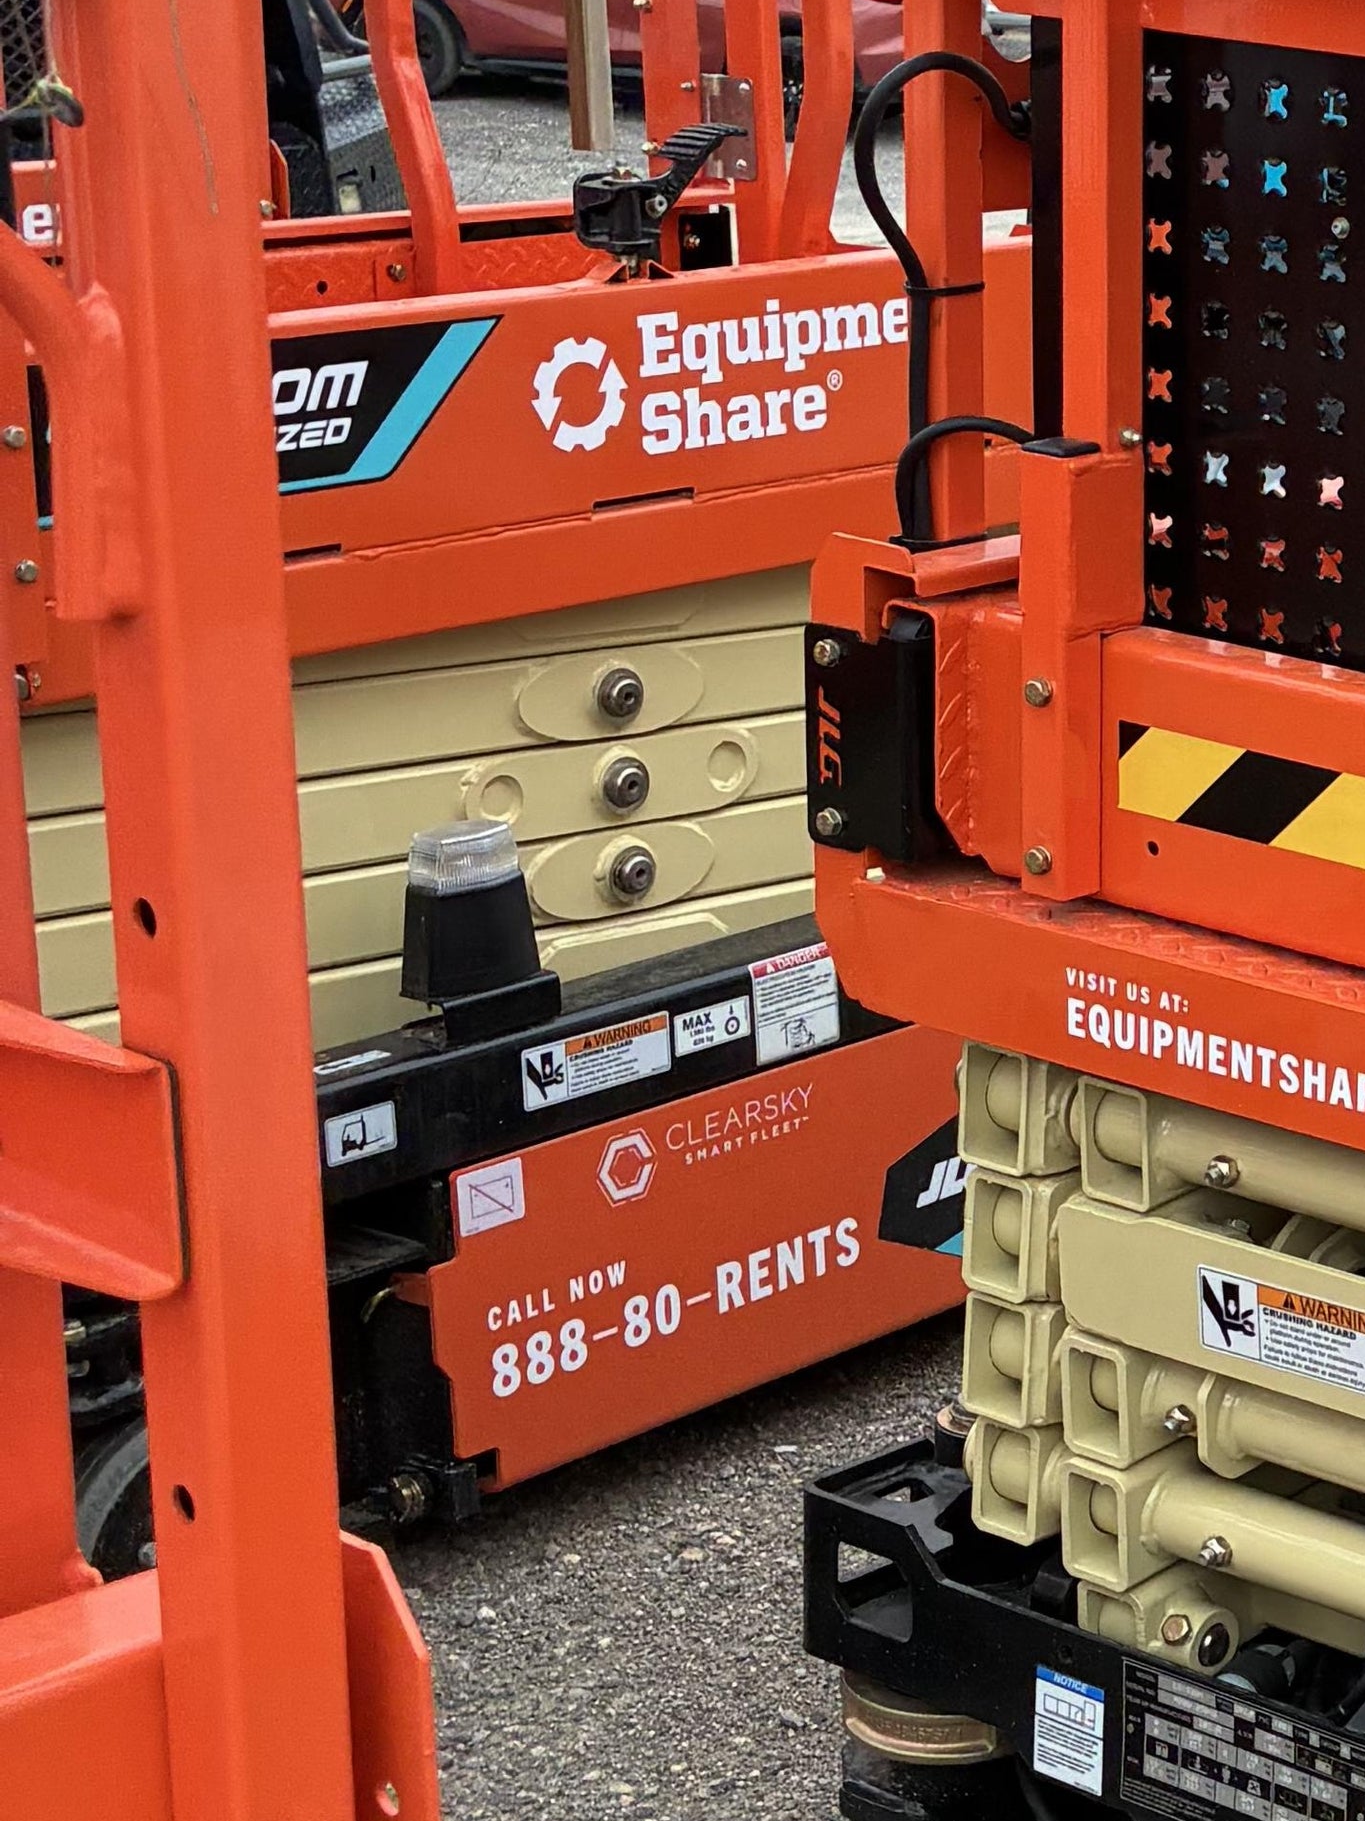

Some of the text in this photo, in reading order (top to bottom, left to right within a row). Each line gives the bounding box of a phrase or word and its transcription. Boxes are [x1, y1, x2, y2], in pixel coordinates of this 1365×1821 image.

[636, 298, 908, 385] Equipme
[819, 685, 842, 787] JLG
[1065, 967, 1190, 1013] VISIT US AT:
[594, 1020, 651, 1046] WARNING
[682, 1012, 712, 1031] MAX
[665, 1083, 813, 1151] CLEARSKY
[685, 1137, 743, 1165] SMART
[487, 1260, 627, 1331] CALL NOW
[491, 1217, 861, 1397] 888-80-RENTS
[1316, 1321, 1357, 1340] HAZARD
[1053, 1673, 1088, 1694] NOTICE
